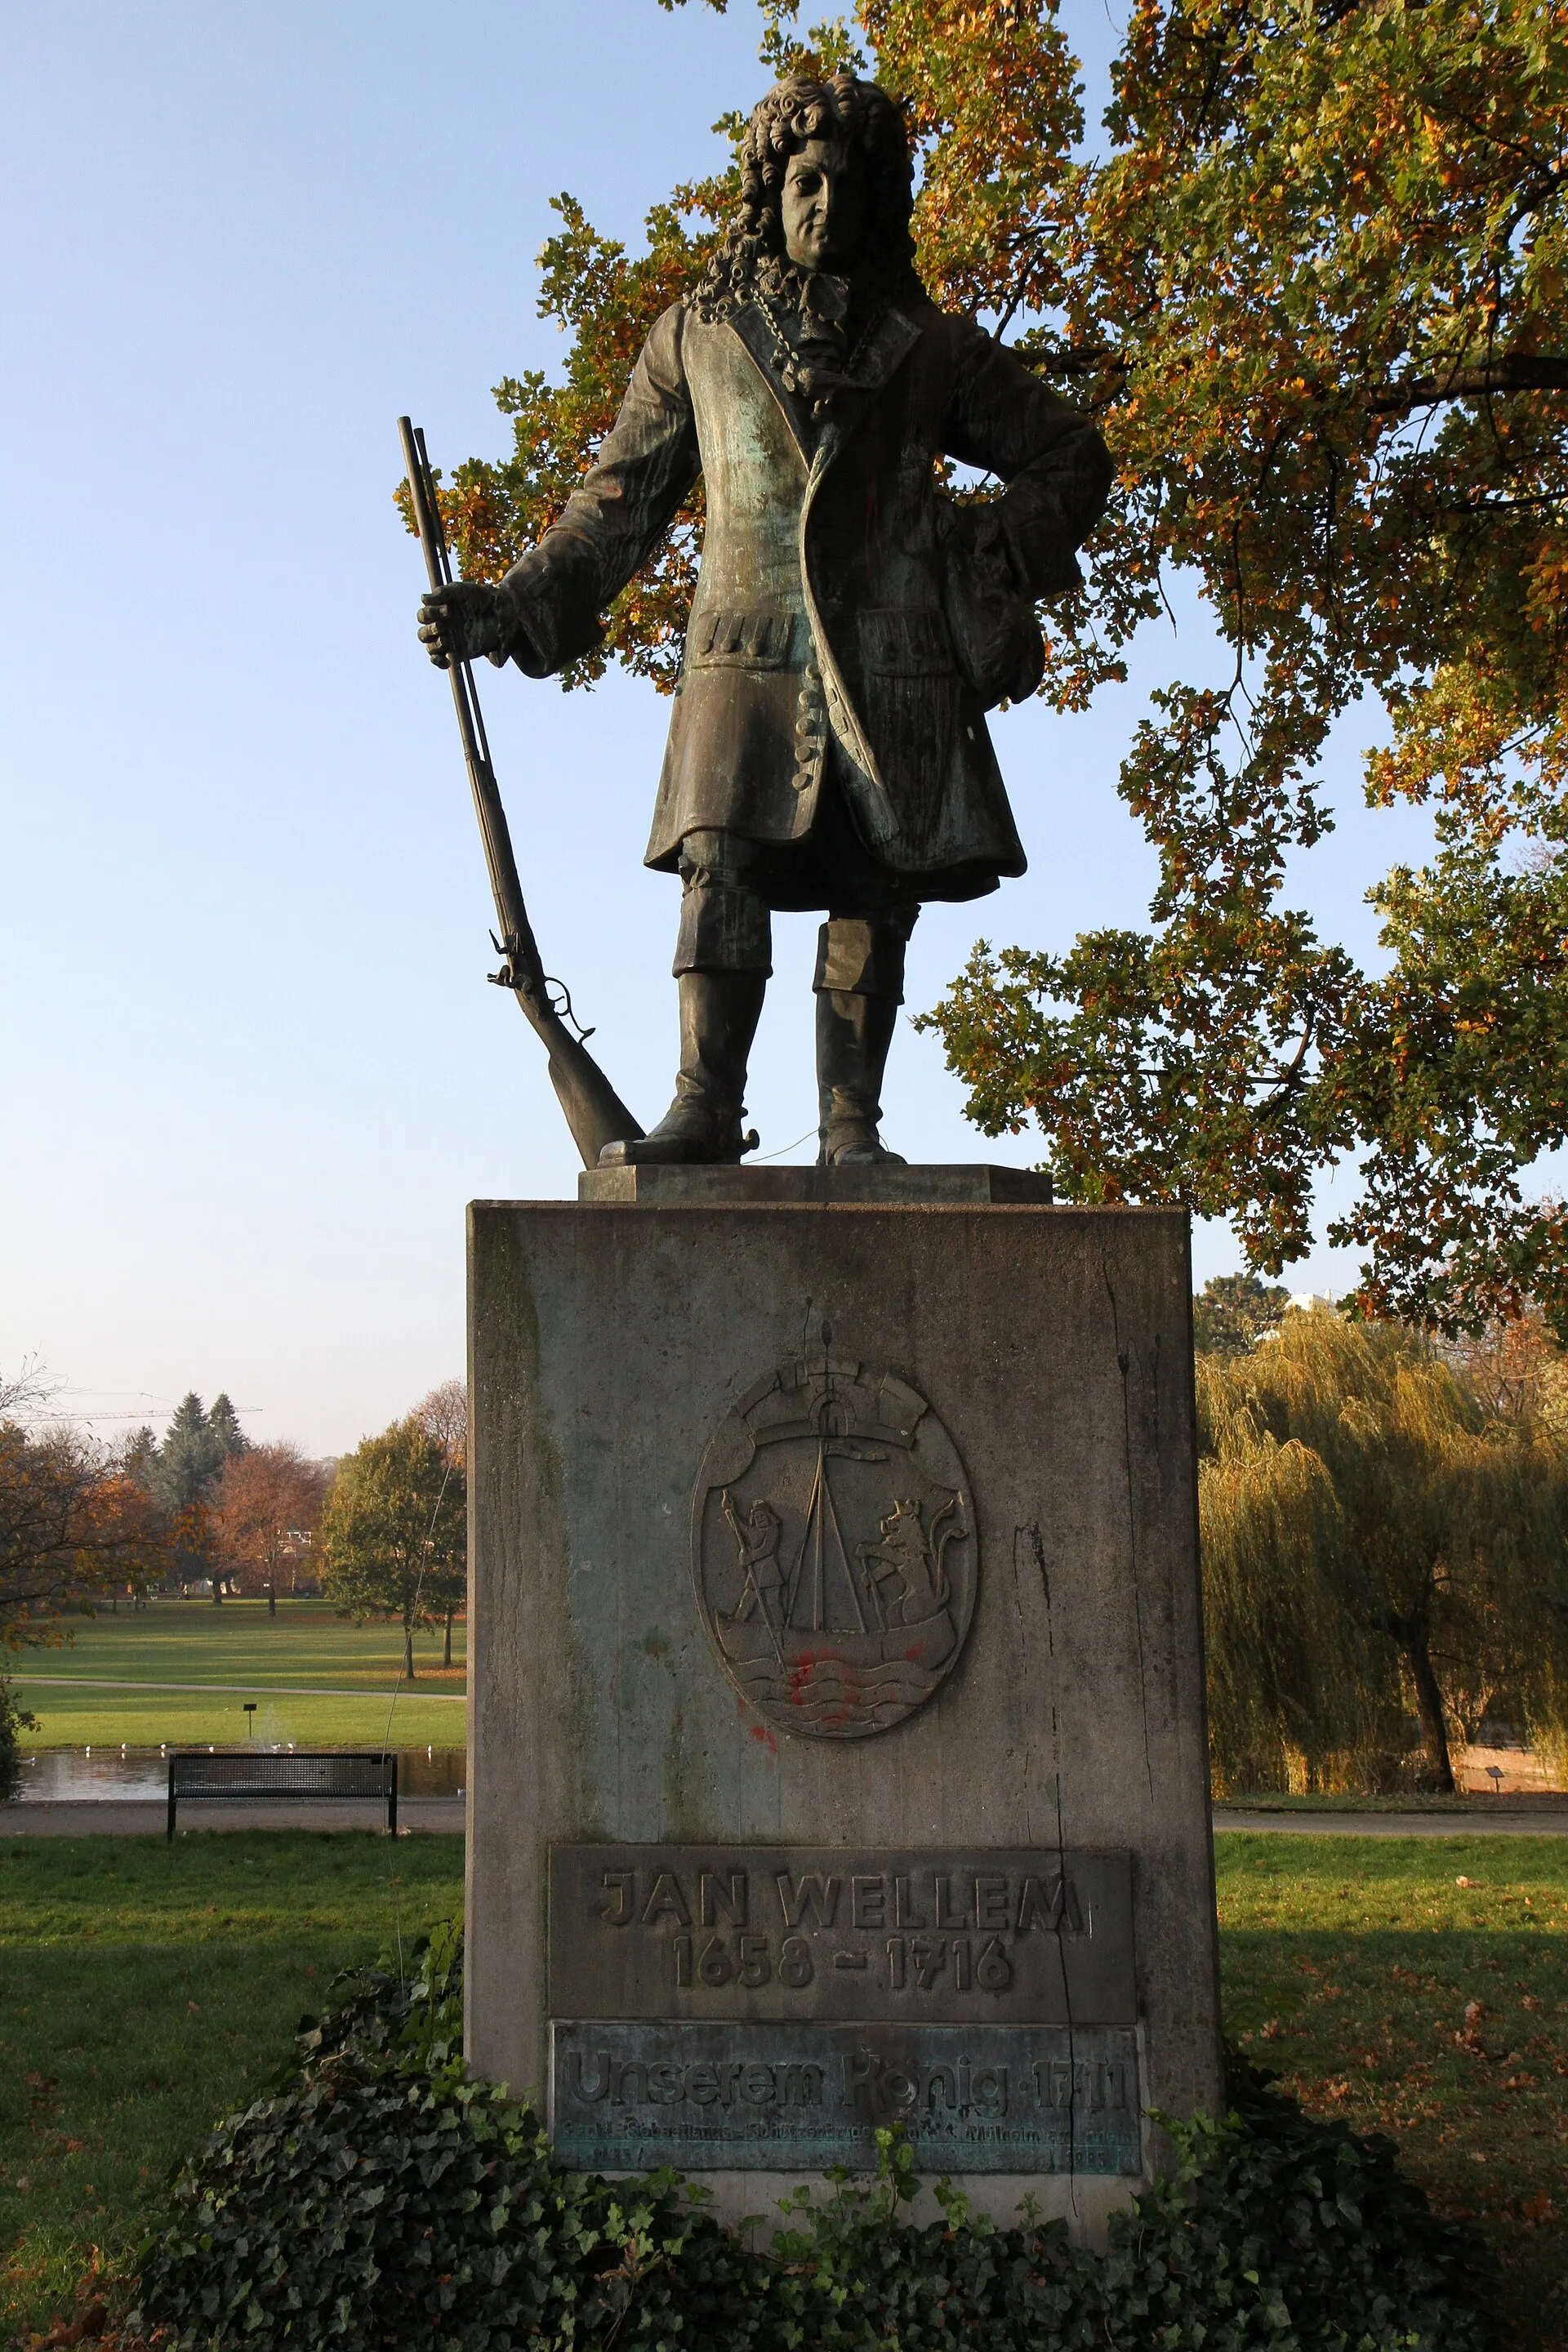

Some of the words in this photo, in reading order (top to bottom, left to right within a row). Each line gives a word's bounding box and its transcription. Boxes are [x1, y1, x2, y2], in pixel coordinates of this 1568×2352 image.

[602, 1873, 750, 1927] JAN
[777, 1875, 1085, 1931] WELLEM
[674, 1936, 813, 1988] 1658
[887, 1938, 1012, 1990] 1716
[568, 2050, 824, 2106] Unserem
[841, 2052, 1010, 2118] König
[1033, 2060, 1128, 2110] 1711
